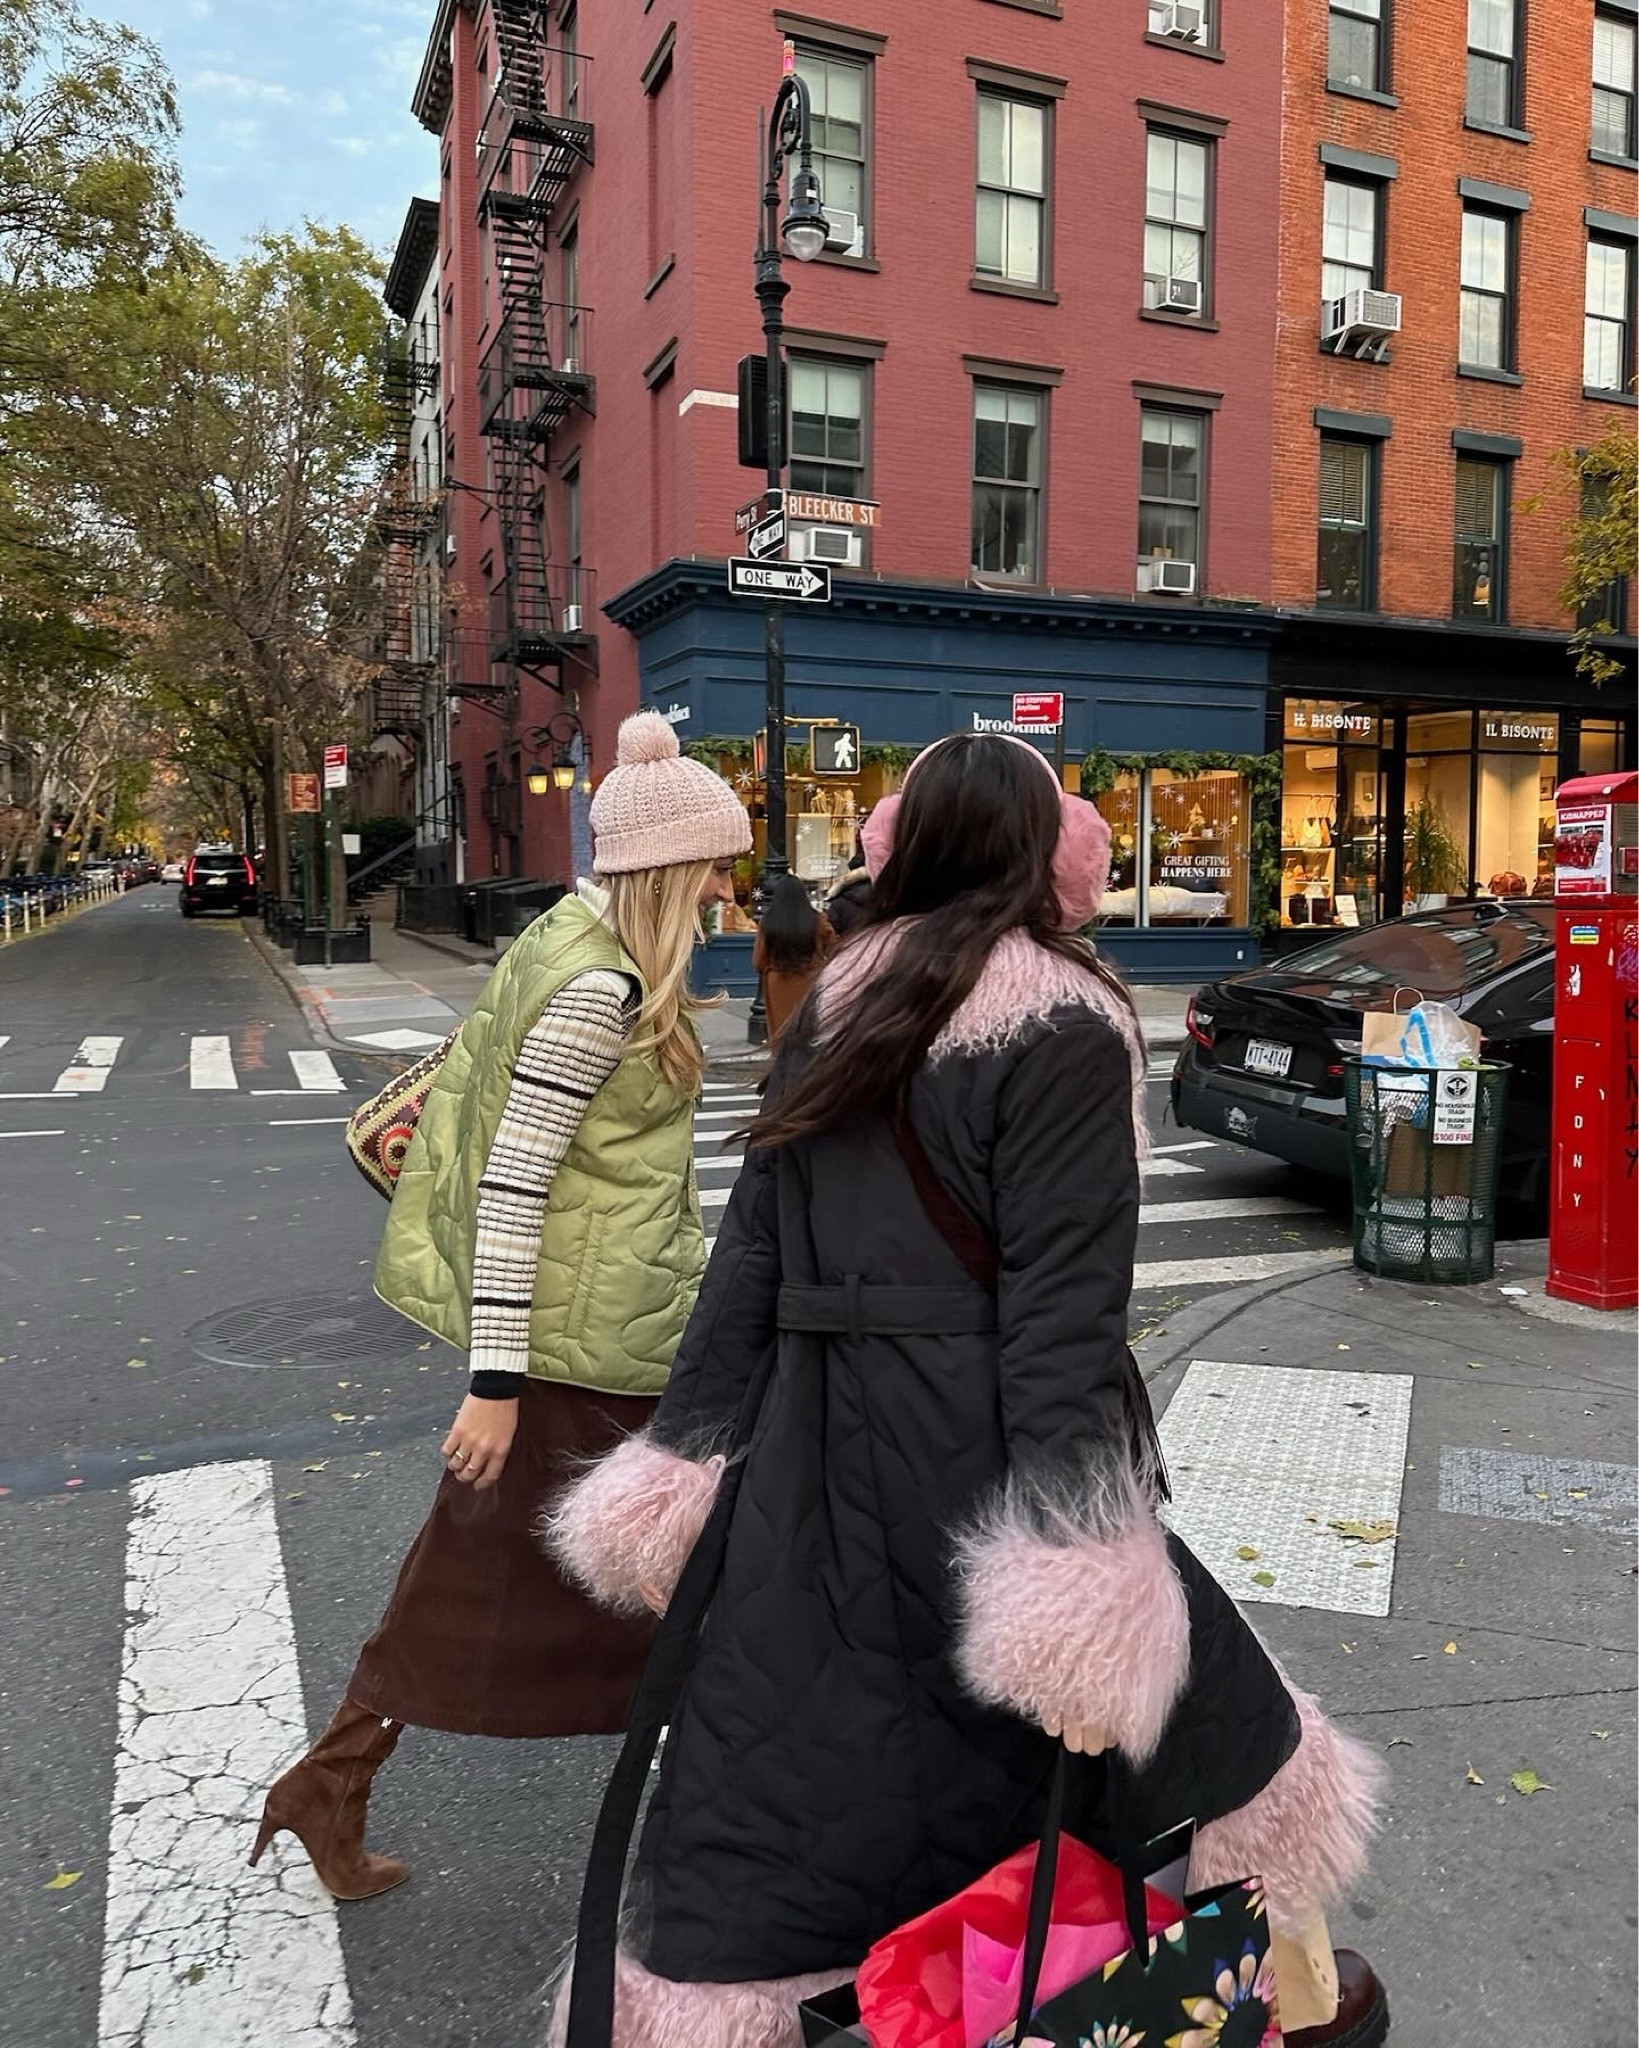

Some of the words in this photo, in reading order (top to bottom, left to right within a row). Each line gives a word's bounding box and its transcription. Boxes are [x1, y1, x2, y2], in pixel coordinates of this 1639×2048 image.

[789, 496, 854, 522] BLEECKER
[860, 505, 875, 525] ST
[768, 522, 782, 541] WAY
[744, 570, 773, 586] ONE
[785, 574, 814, 590] WAY
[1293, 713, 1307, 728] IL
[1311, 714, 1371, 730] BISONTE
[1485, 724, 1498, 737] IL
[1501, 725, 1555, 739] BISONTE
[1164, 856, 1193, 866] GREAT
[1194, 856, 1229, 866] GIFTING
[1161, 867, 1205, 877] HAPPENS
[1206, 867, 1233, 878] HERE
[1434, 1132, 1454, 1141] $100
[1455, 1132, 1473, 1142] FINE
